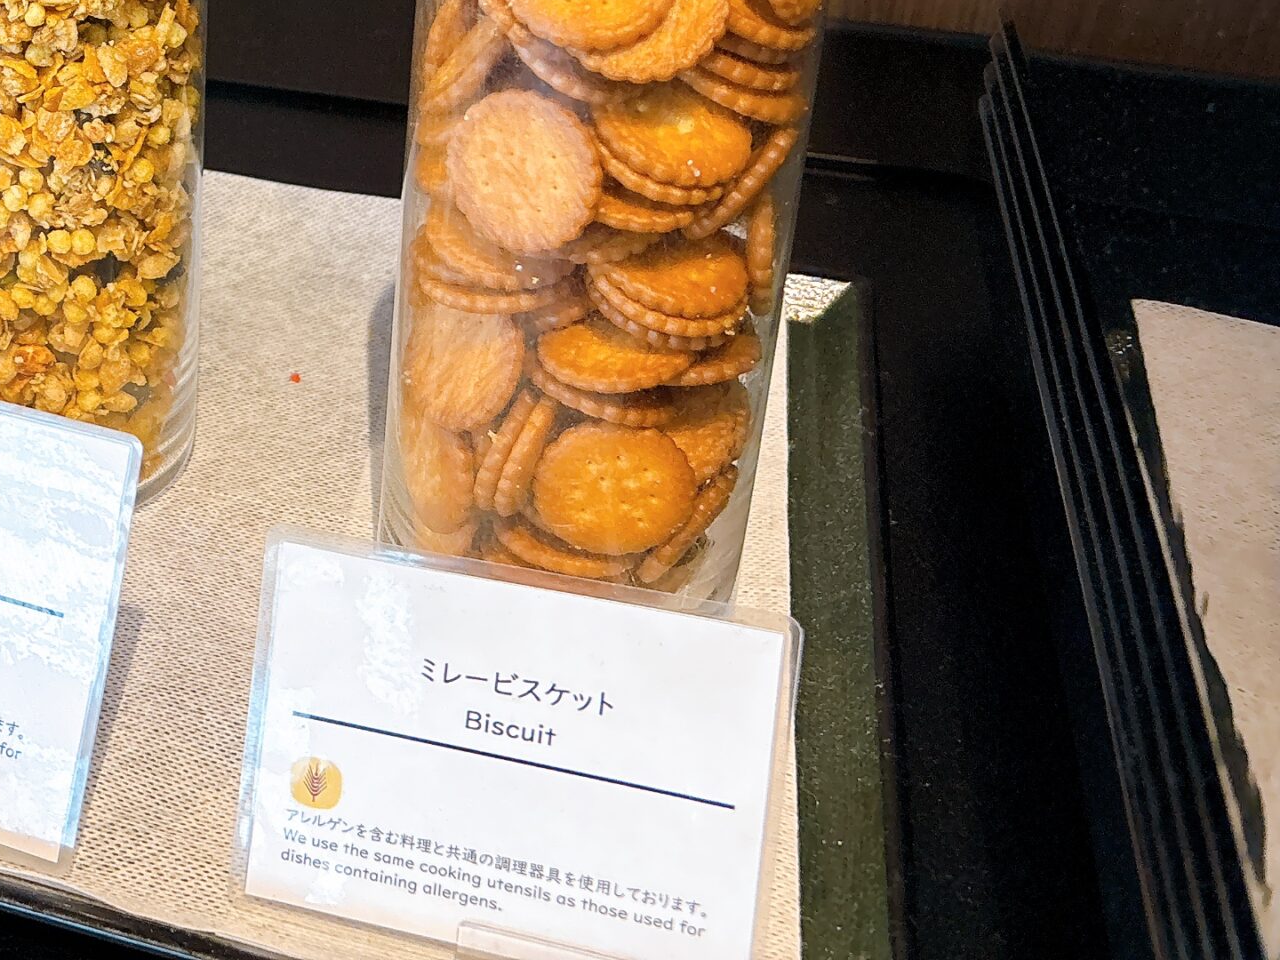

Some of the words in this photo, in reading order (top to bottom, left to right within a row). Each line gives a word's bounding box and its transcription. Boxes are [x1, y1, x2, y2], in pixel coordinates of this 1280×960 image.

[420, 657, 615, 716] ミレービスケット
[465, 709, 558, 747] Biscuit
[280, 847, 330, 872] dishes
[334, 862, 418, 895] containing
[422, 881, 503, 913] allergens.
[283, 826, 308, 846] We
[311, 836, 339, 852] use
[343, 842, 370, 860] the
[373, 851, 416, 870] same
[419, 861, 483, 890] cooking
[487, 877, 552, 902] utensils
[556, 894, 577, 908] as
[580, 897, 628, 921] those
[633, 911, 674, 932] used
[679, 919, 707, 938] for
